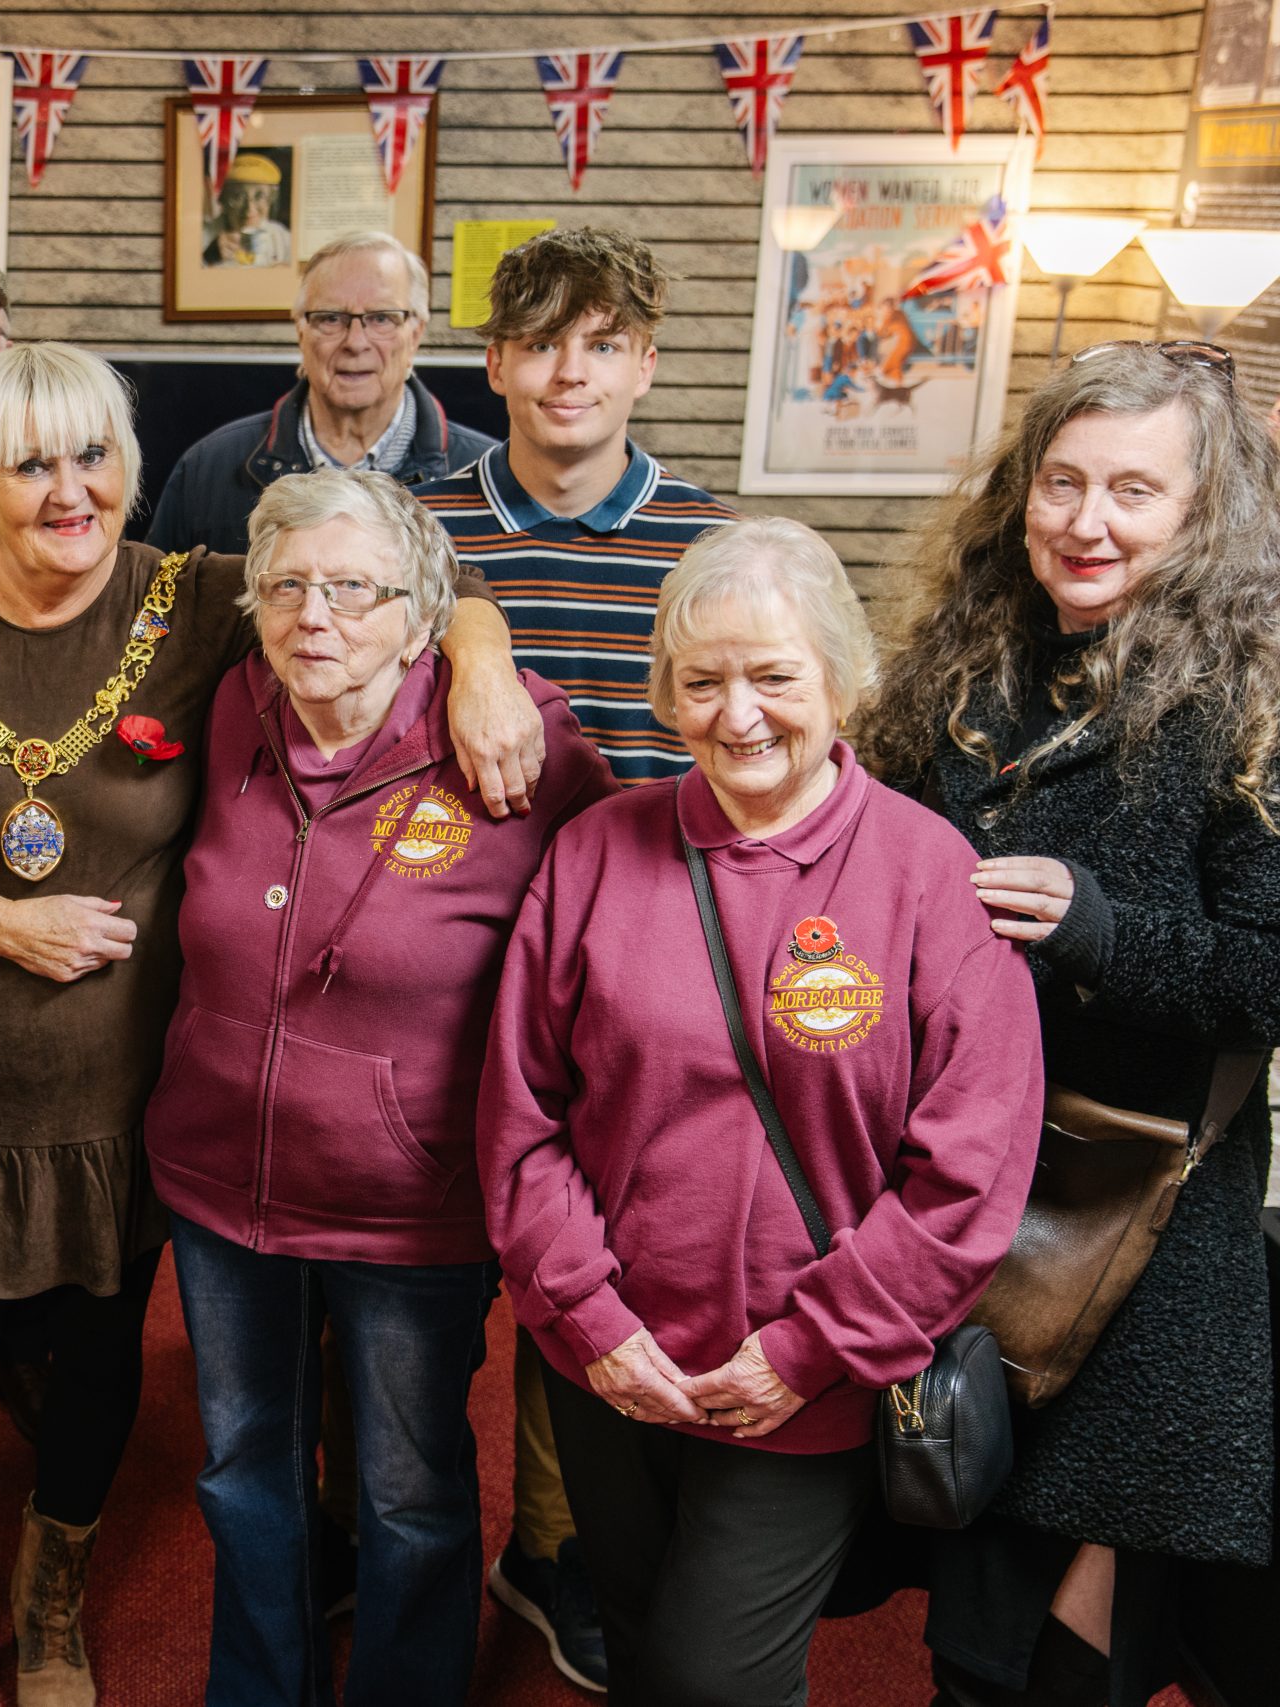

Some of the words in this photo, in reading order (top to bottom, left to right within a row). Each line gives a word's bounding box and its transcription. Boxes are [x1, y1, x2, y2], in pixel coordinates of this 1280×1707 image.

[370, 819, 472, 845] MOECAMBE
[784, 951, 868, 975] HEAGE
[770, 989, 884, 1011] MORECAMBE
[786, 1026, 869, 1053] HERITAGE
